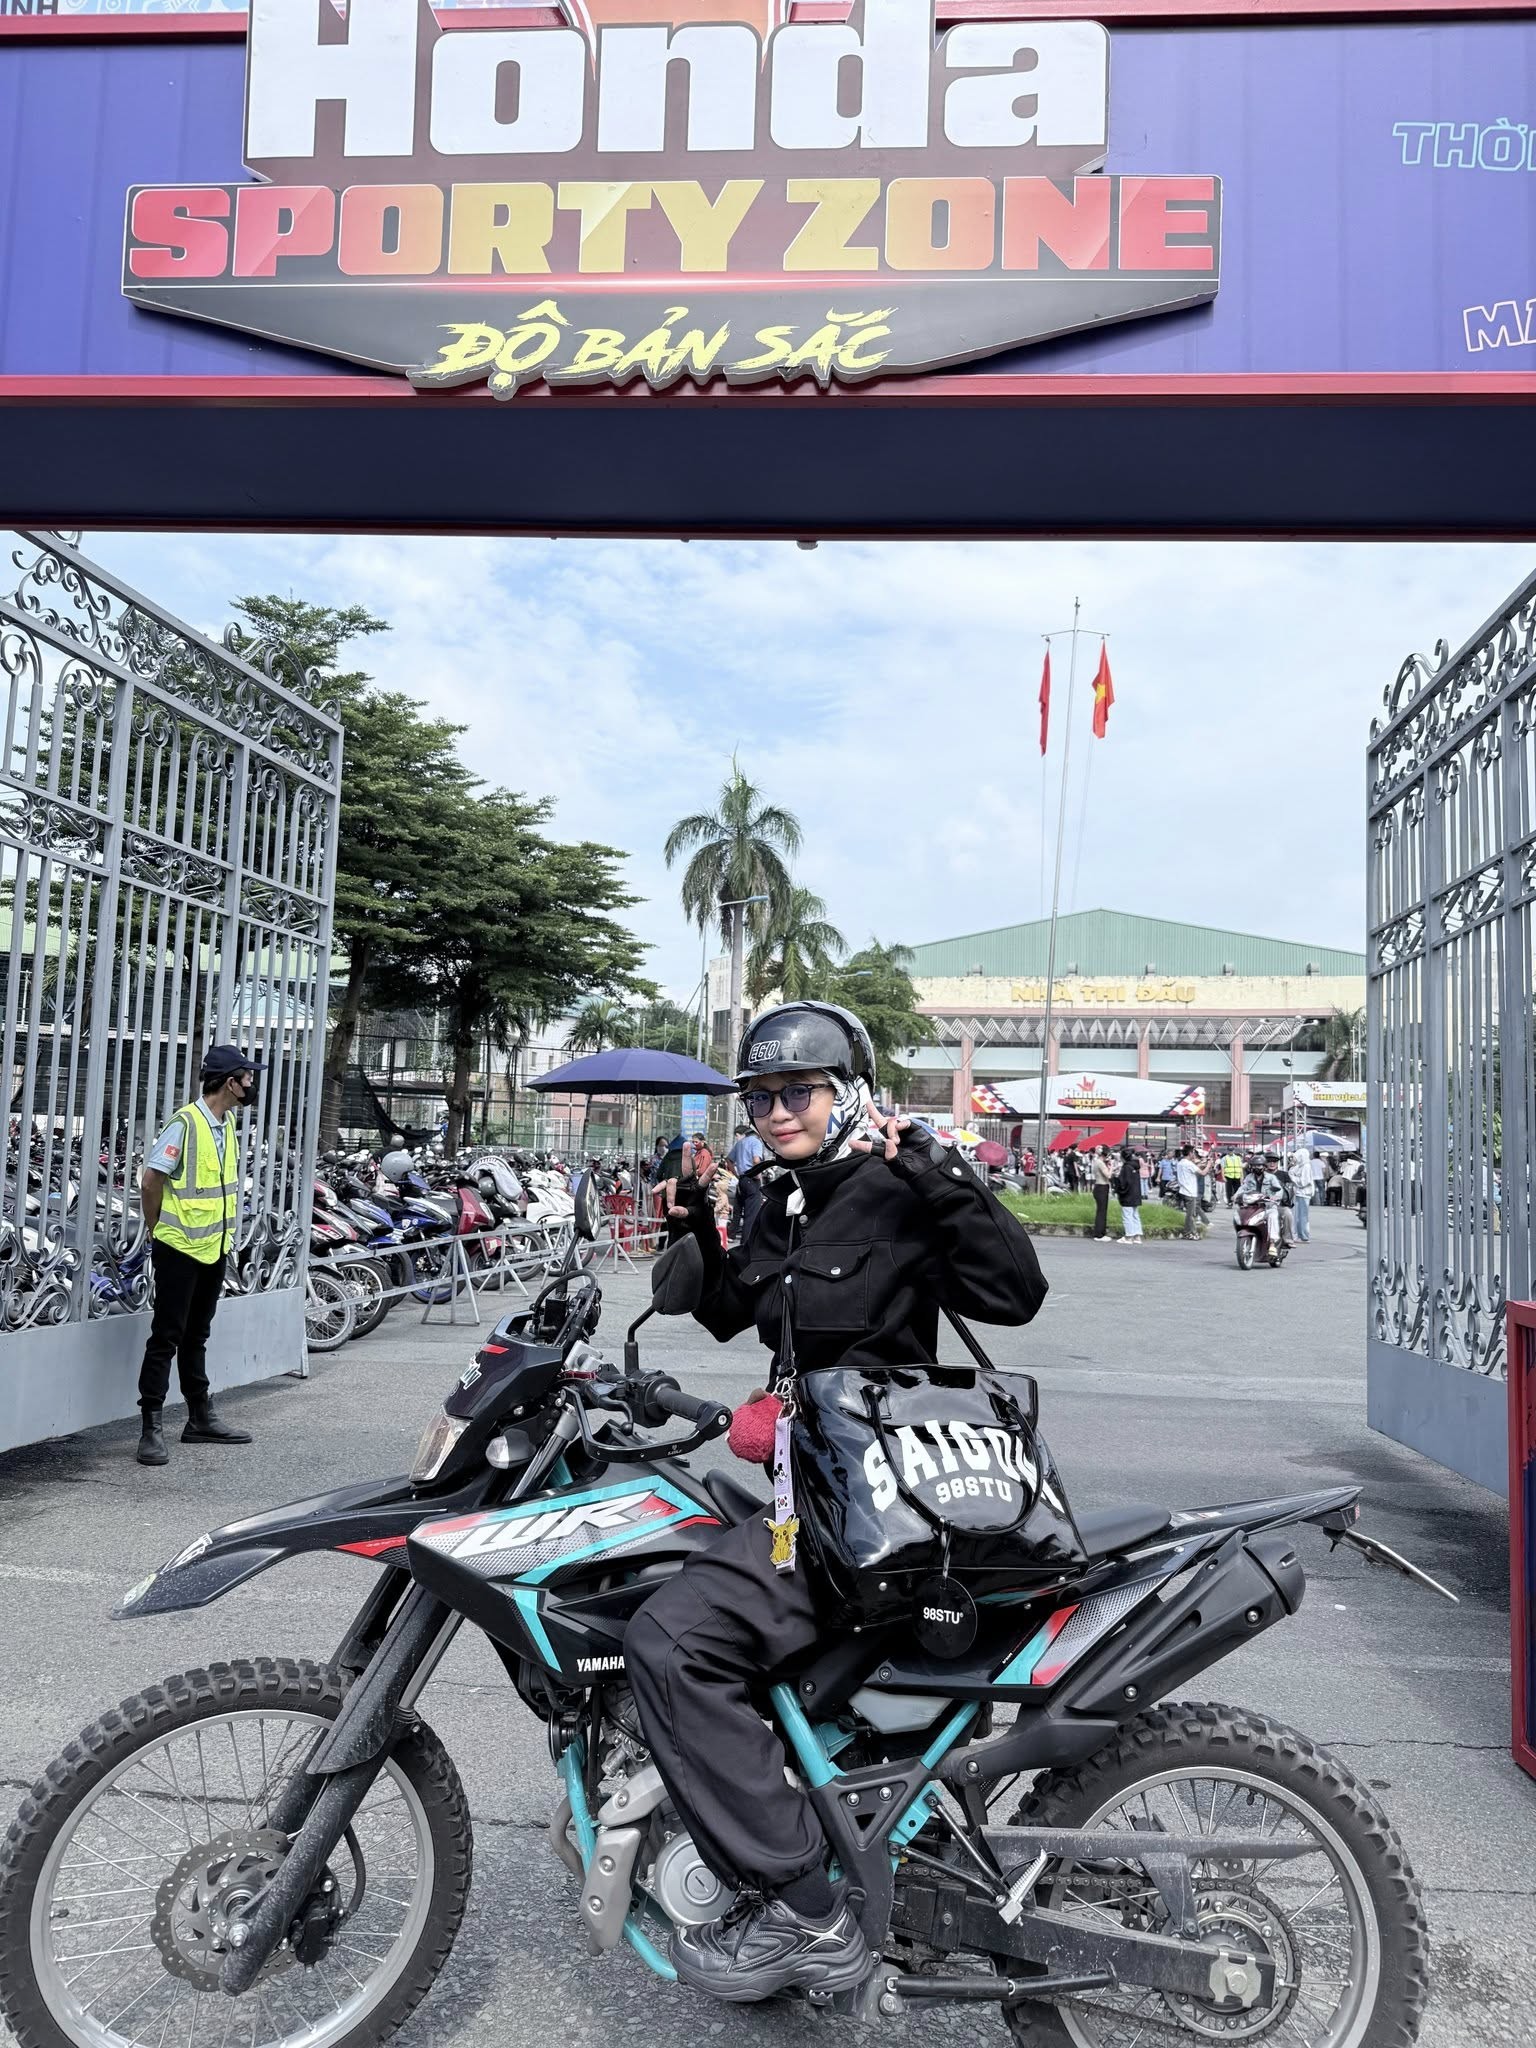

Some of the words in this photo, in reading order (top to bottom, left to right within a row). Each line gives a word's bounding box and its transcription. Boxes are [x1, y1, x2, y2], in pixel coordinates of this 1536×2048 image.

[247, 0, 1106, 158] Honda
[129, 180, 765, 278] SPORTY
[783, 176, 1214, 272] ZONE
[425, 300, 573, 390] ĐỘ
[557, 306, 731, 379] BẢN
[726, 307, 899, 375] SẮC
[1080, 985, 1126, 1002] THI
[749, 1040, 780, 1063] EGO
[935, 1476, 1013, 1505] 98STU
[450, 1489, 658, 1559] WR
[576, 1655, 626, 1673] YAMAHA
